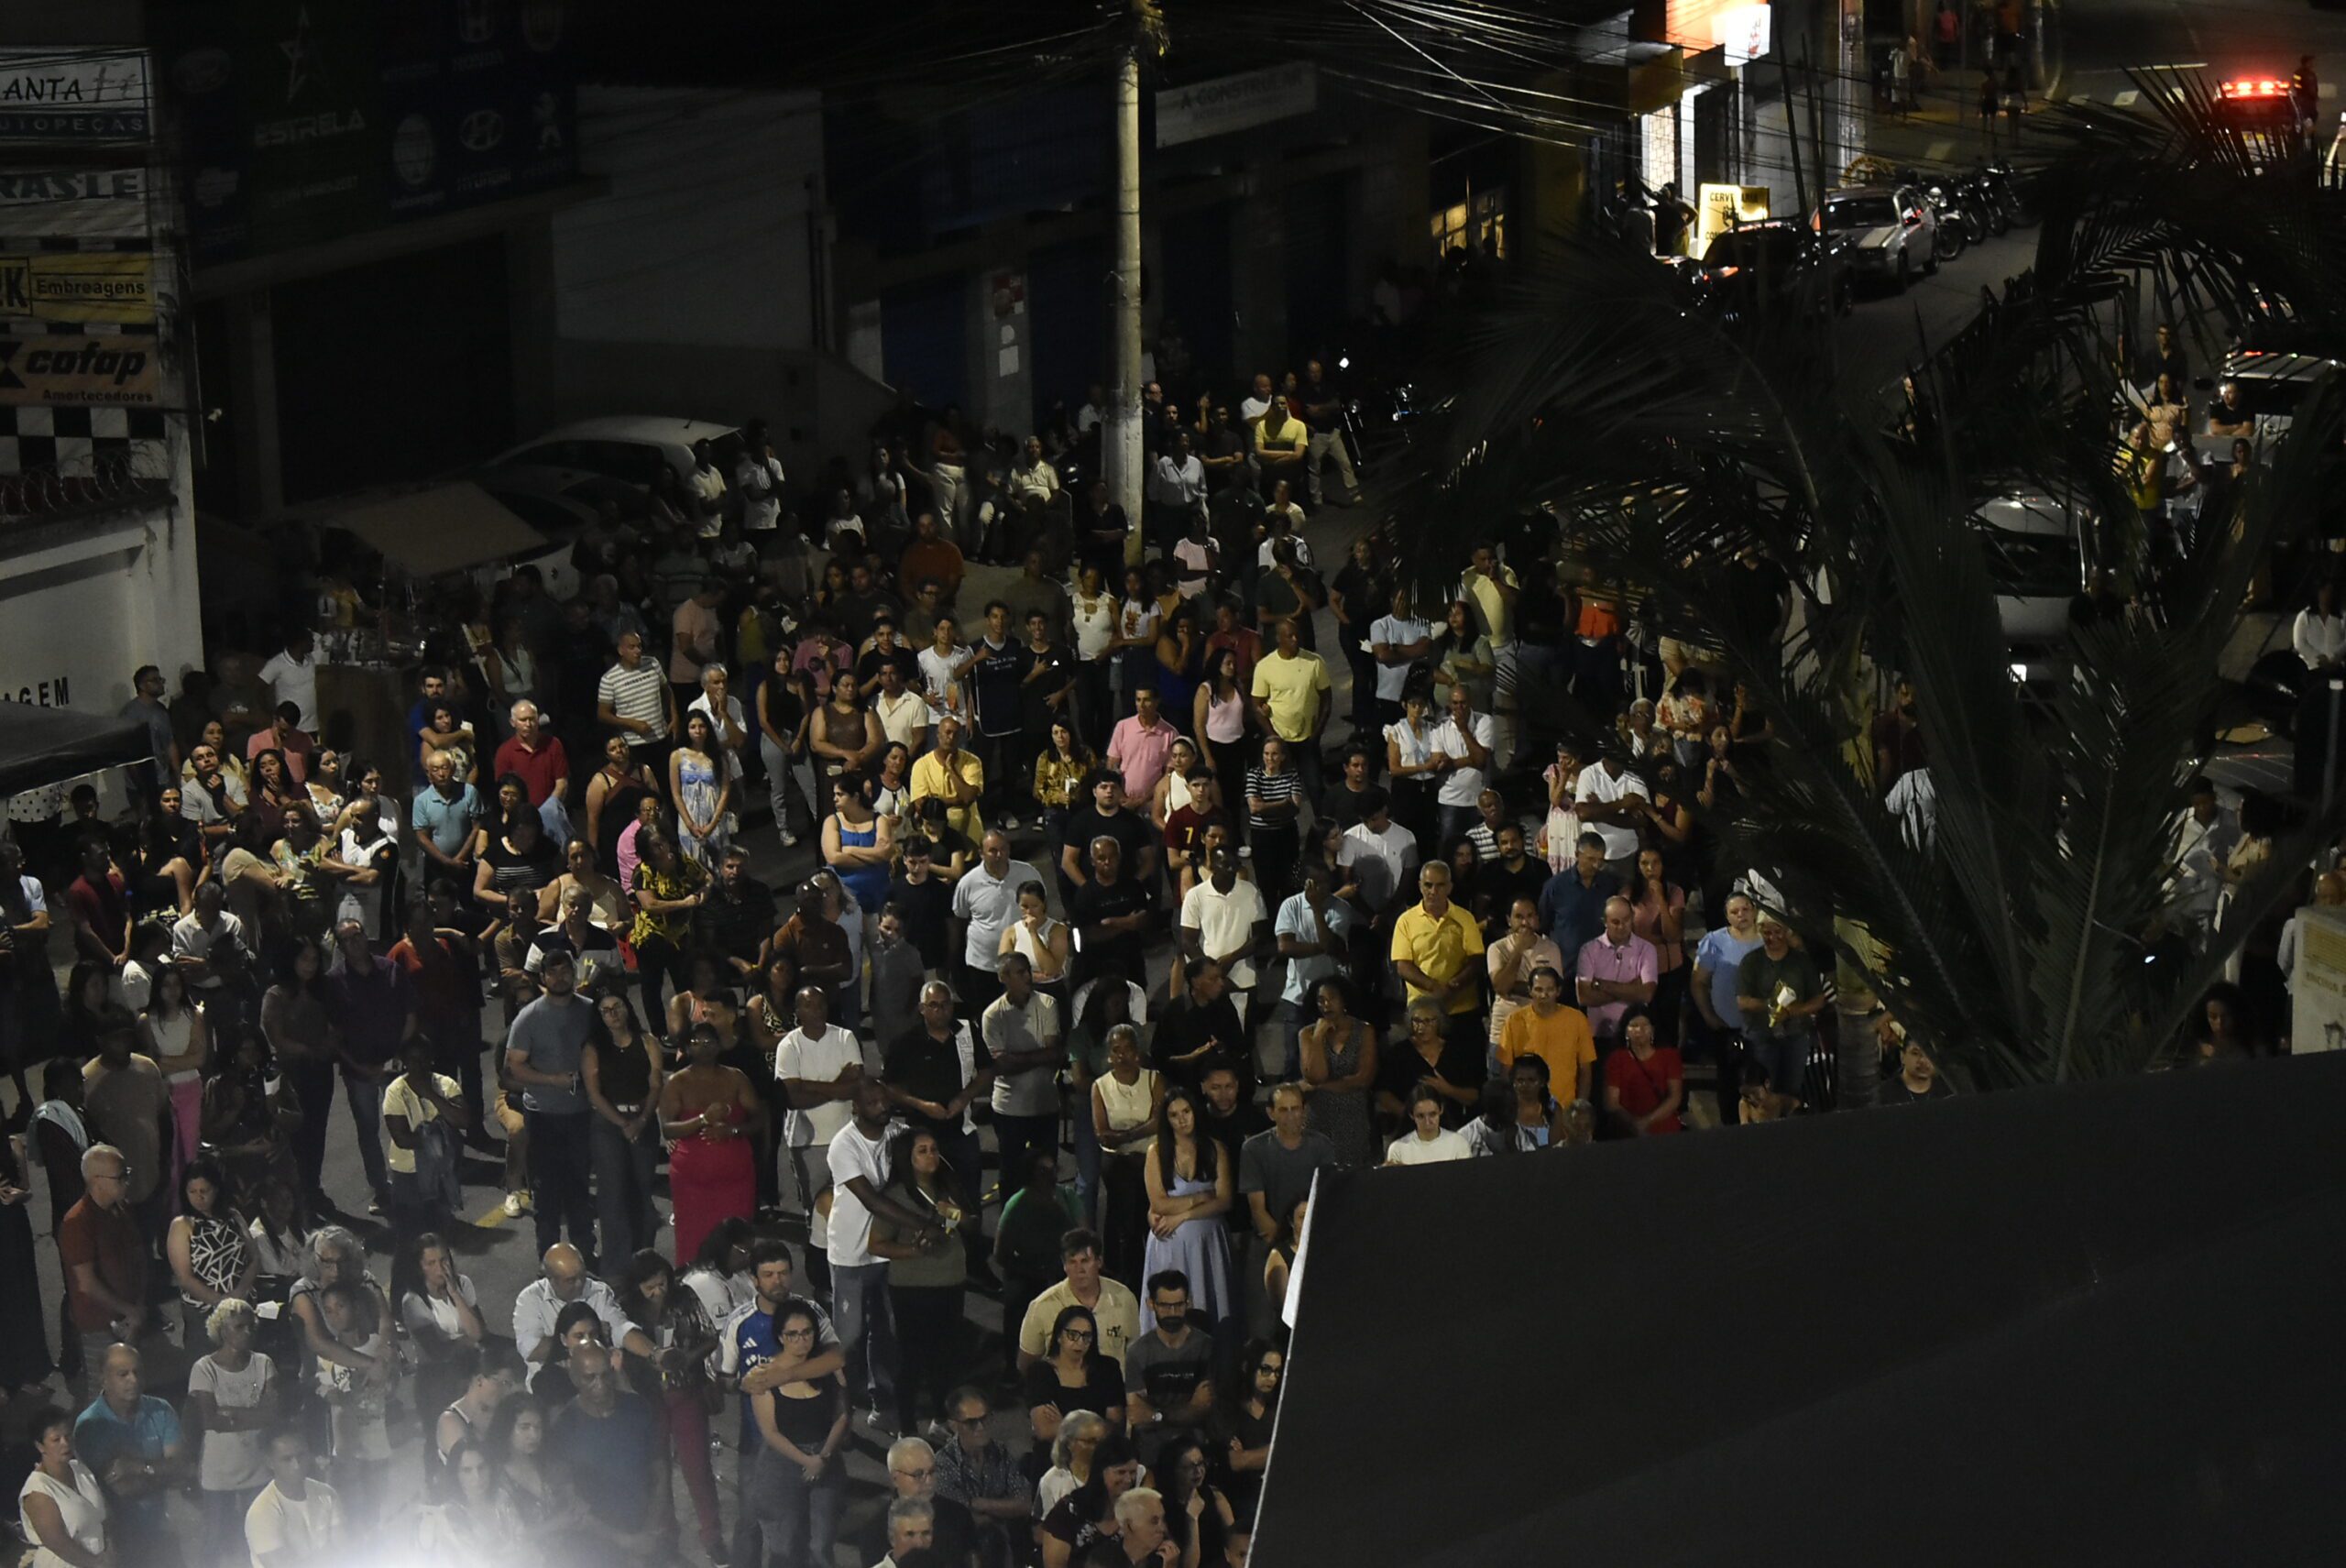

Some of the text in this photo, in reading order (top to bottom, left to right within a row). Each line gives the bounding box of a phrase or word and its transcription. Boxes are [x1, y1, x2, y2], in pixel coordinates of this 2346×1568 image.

[254, 107, 367, 148] ESTRELA
[37, 280, 145, 297] Embreagens
[27, 341, 147, 385] cofap
[43, 389, 153, 402] Amortecedores
[1184, 826, 1194, 845] 7
